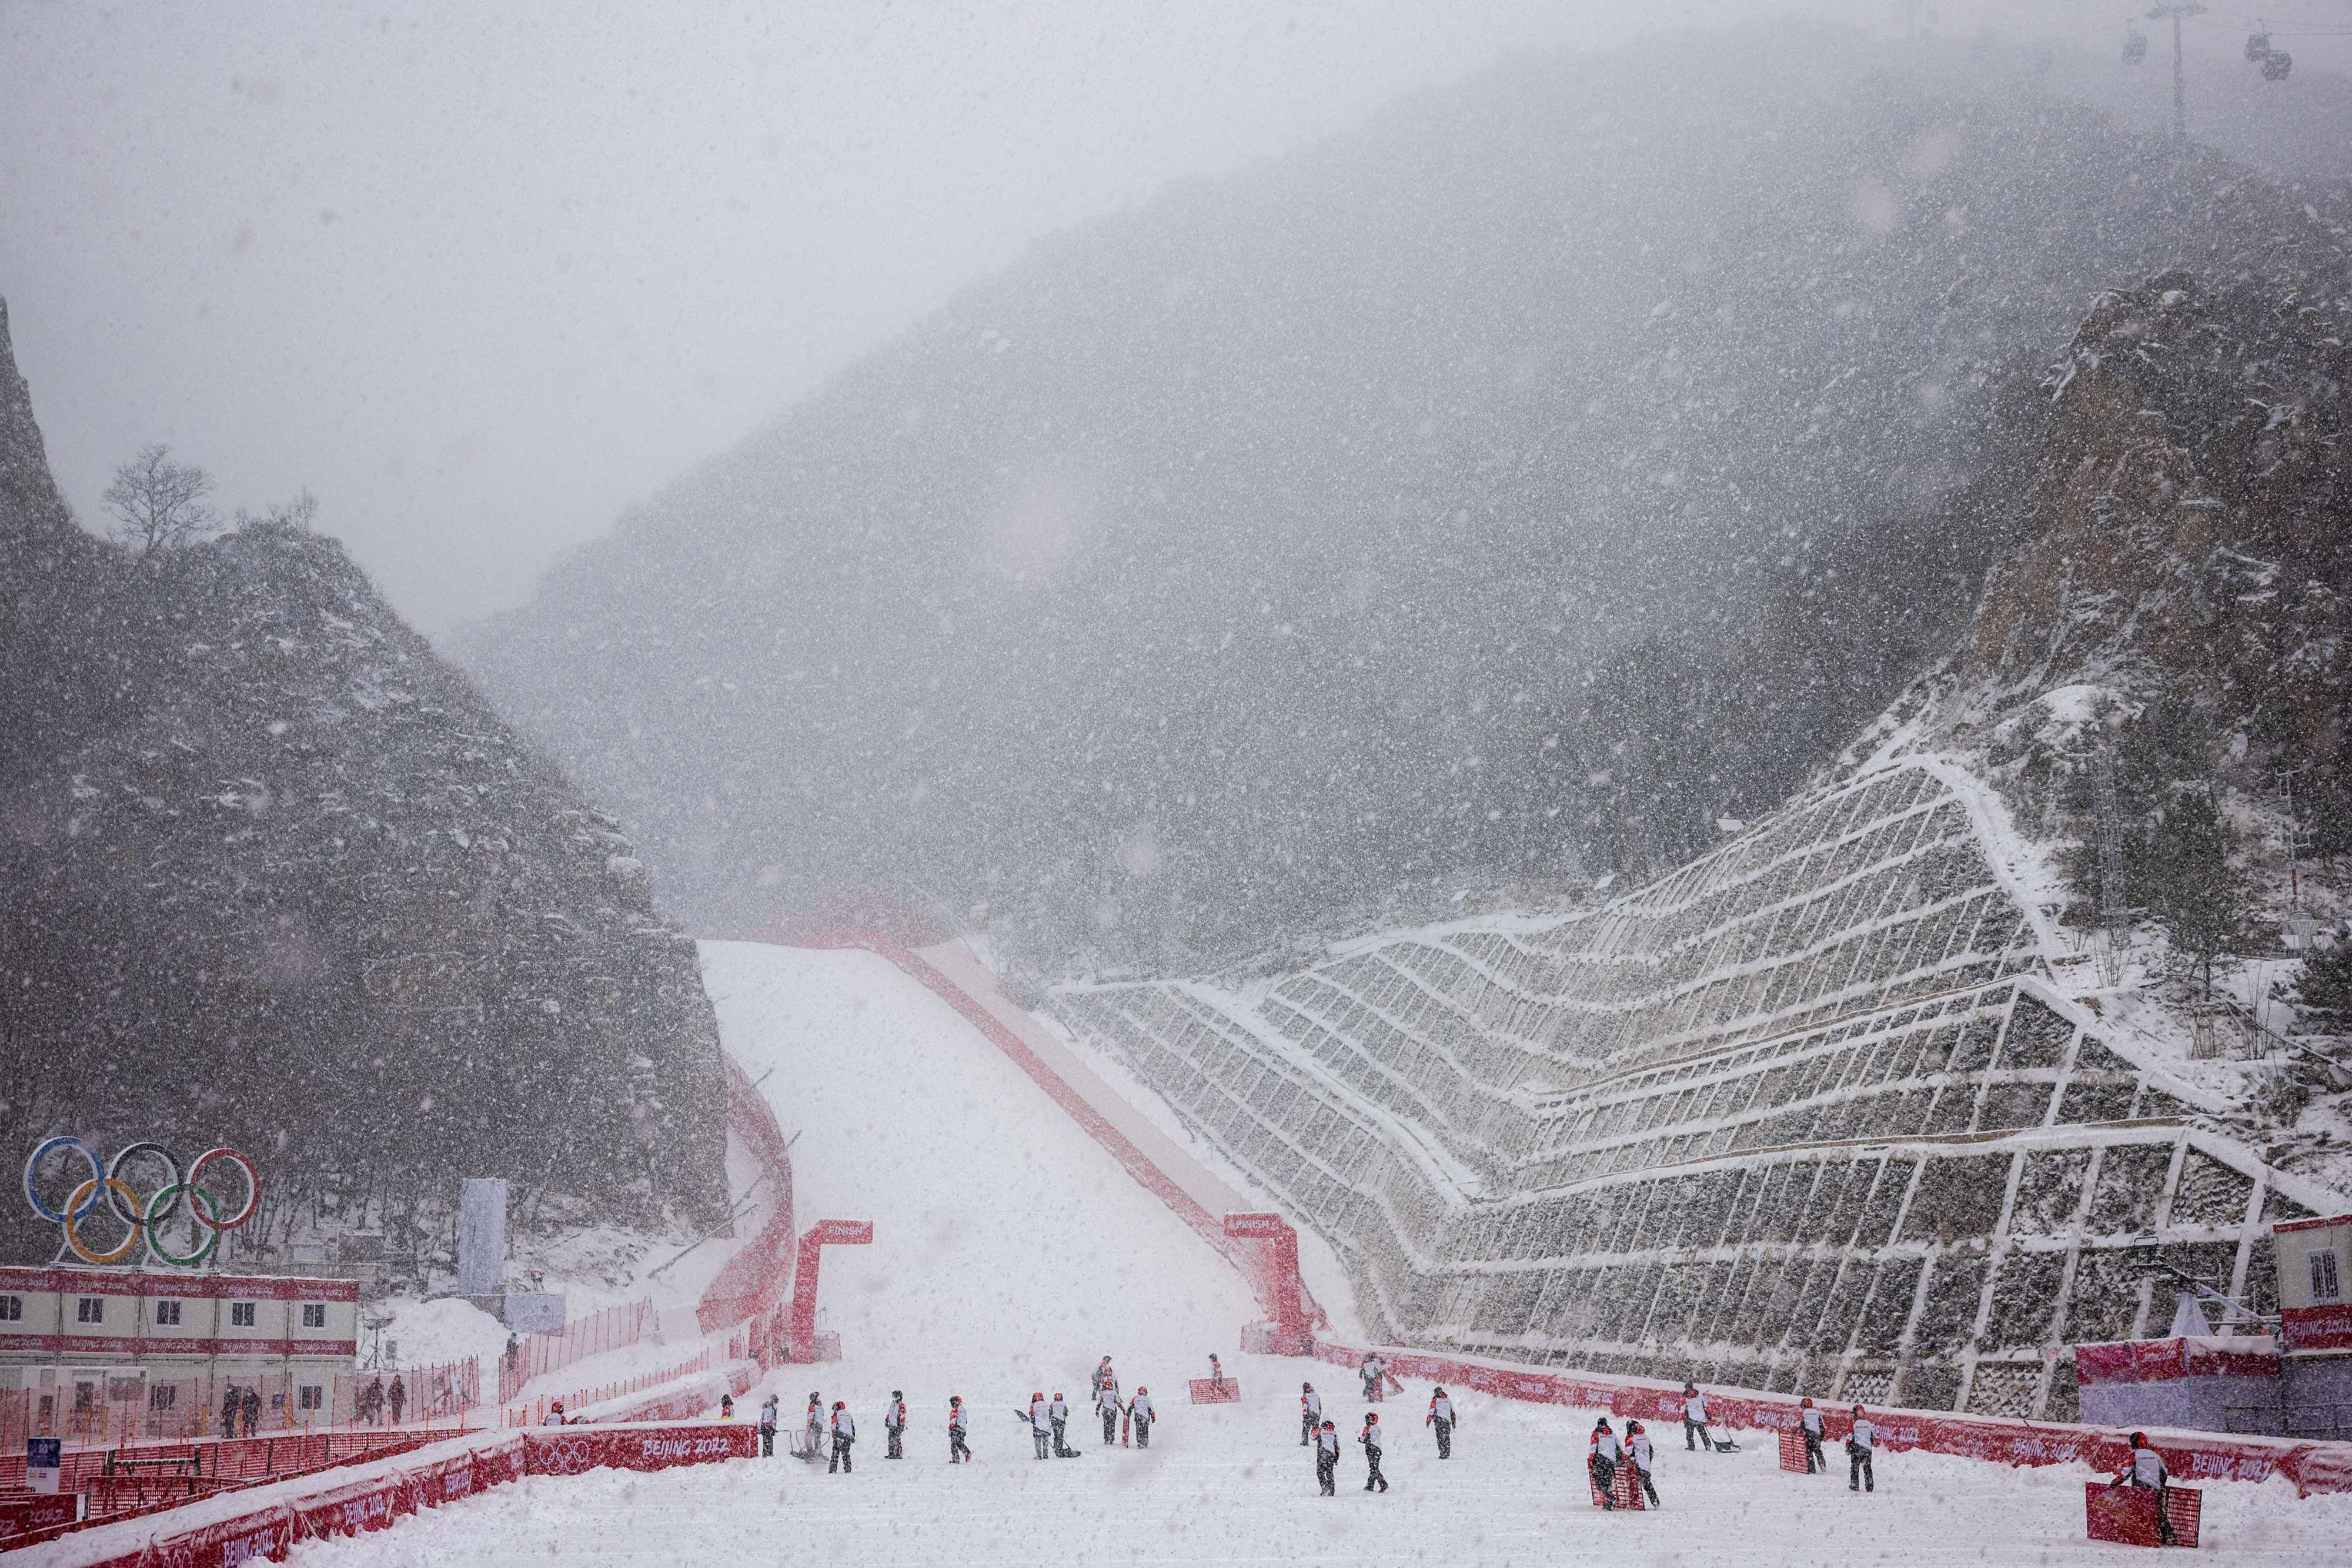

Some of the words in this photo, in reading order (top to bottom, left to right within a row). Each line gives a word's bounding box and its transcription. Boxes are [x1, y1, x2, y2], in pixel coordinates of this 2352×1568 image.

[828, 1224, 863, 1235] FINISH
[77, 1281, 104, 1291] BEIJING
[107, 1281, 128, 1290] 2022
[155, 1283, 180, 1293] BEIJING
[228, 1286, 254, 1295] BEIJING
[2286, 1321, 2322, 1341] BEIJING
[2326, 1318, 2352, 1334] 2022
[72, 1339, 99, 1350] BEIJING
[149, 1342, 176, 1351] BEIJING
[294, 1343, 319, 1352] BEIJING
[1756, 1410, 1780, 1429] BEIJING
[1899, 1427, 1920, 1442] 2022
[642, 1439, 691, 1460] BEIJING
[694, 1437, 730, 1455] 2022
[2013, 1437, 2046, 1460] BEIJING
[2191, 1453, 2234, 1477] BEIJING
[2238, 1458, 2273, 1479] 2022
[345, 1500, 368, 1529] BEIJING
[368, 1493, 386, 1518] 2022
[223, 1536, 253, 1568] BEIJING
[254, 1528, 276, 1553] 2022
